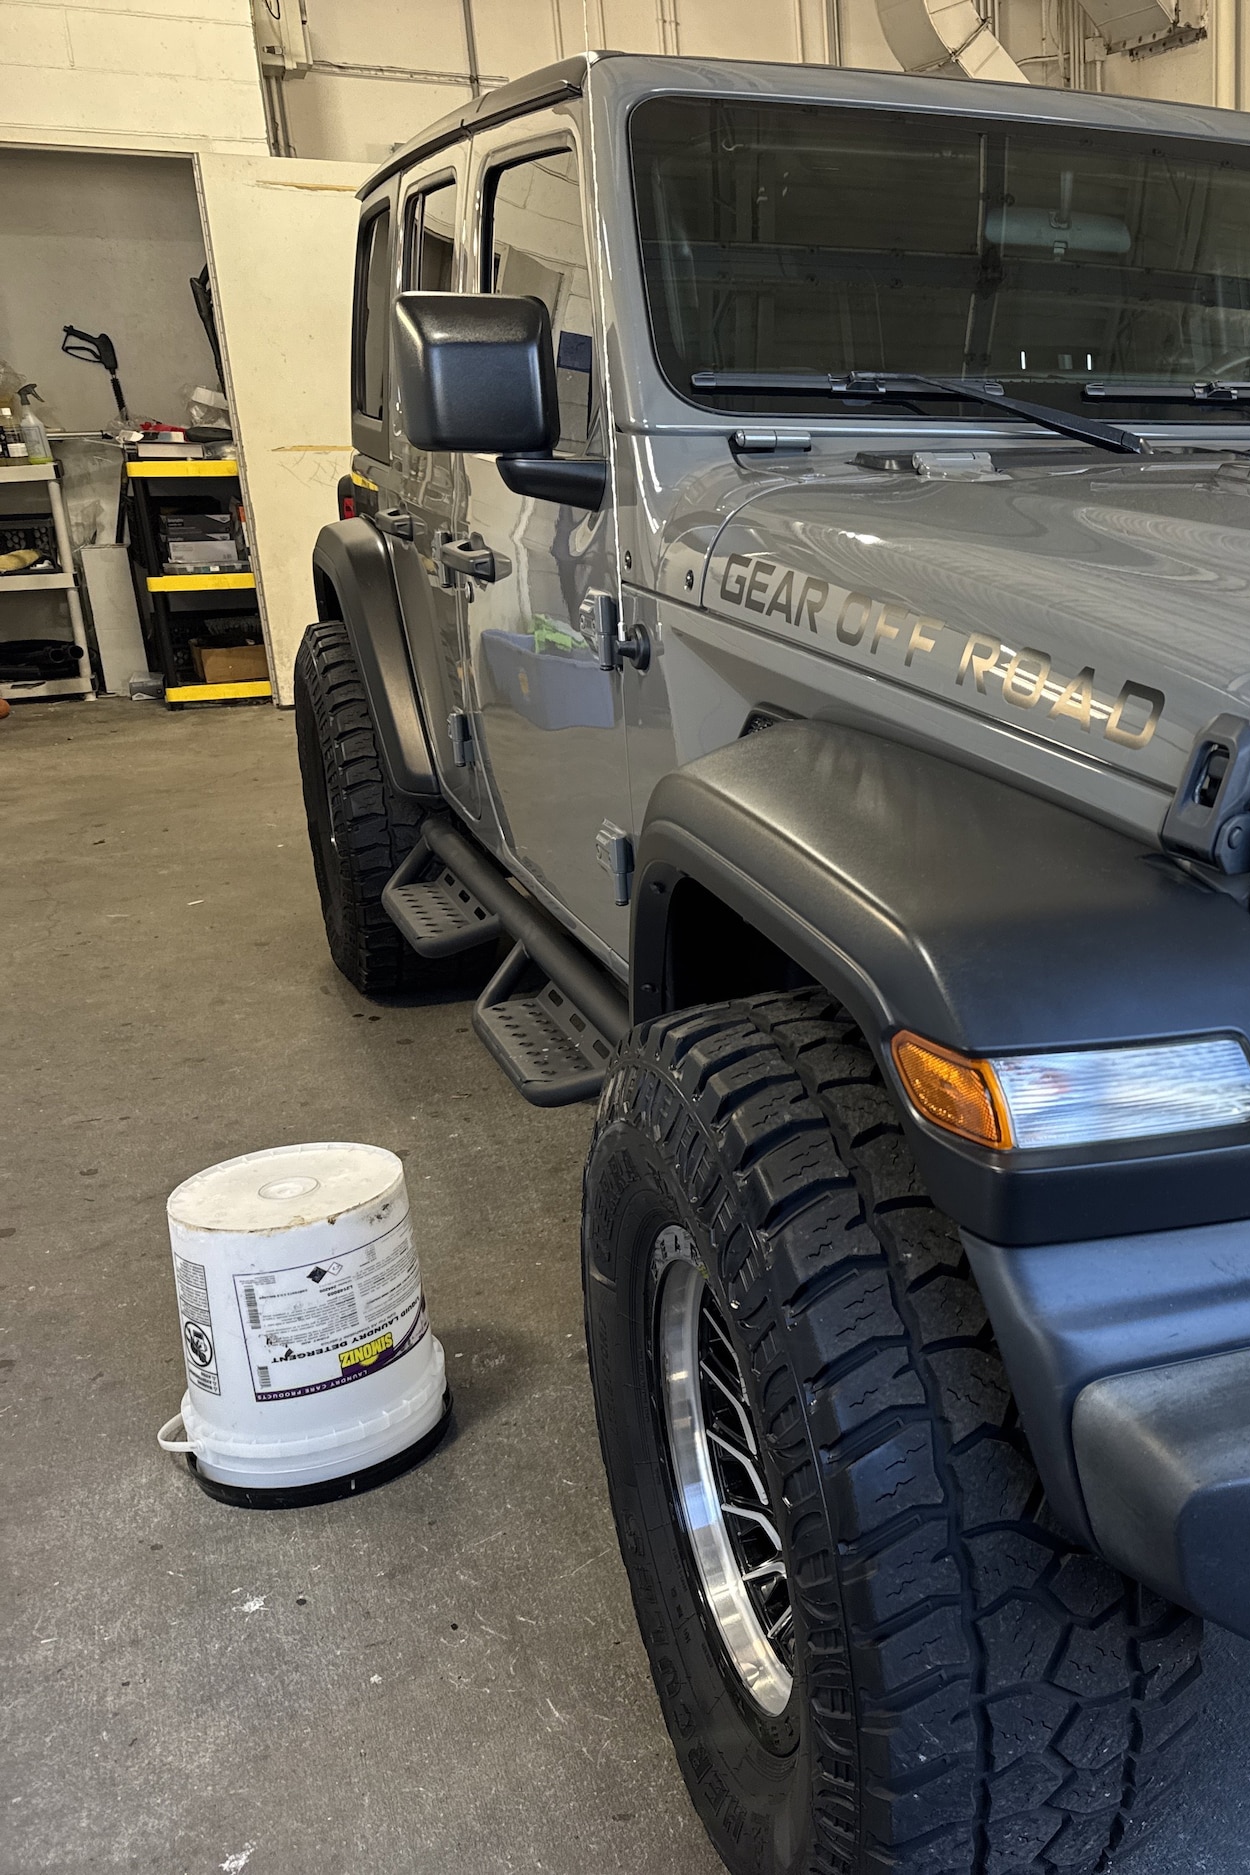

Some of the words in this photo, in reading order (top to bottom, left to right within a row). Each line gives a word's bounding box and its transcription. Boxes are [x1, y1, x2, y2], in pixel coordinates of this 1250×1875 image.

[719, 552, 830, 634] GEAR
[835, 592, 947, 668] OFF
[955, 631, 1166, 751] ROAD
[400, 1296, 420, 1317] LIQUID
[351, 1316, 399, 1344] LAUNDRY
[271, 1341, 347, 1364] DETERGENT
[338, 1332, 393, 1368] SIMONIZ
[330, 1369, 368, 1387] LAUNDRY
[257, 1390, 301, 1400] PRODUCTS
[304, 1384, 326, 1395] CARE
